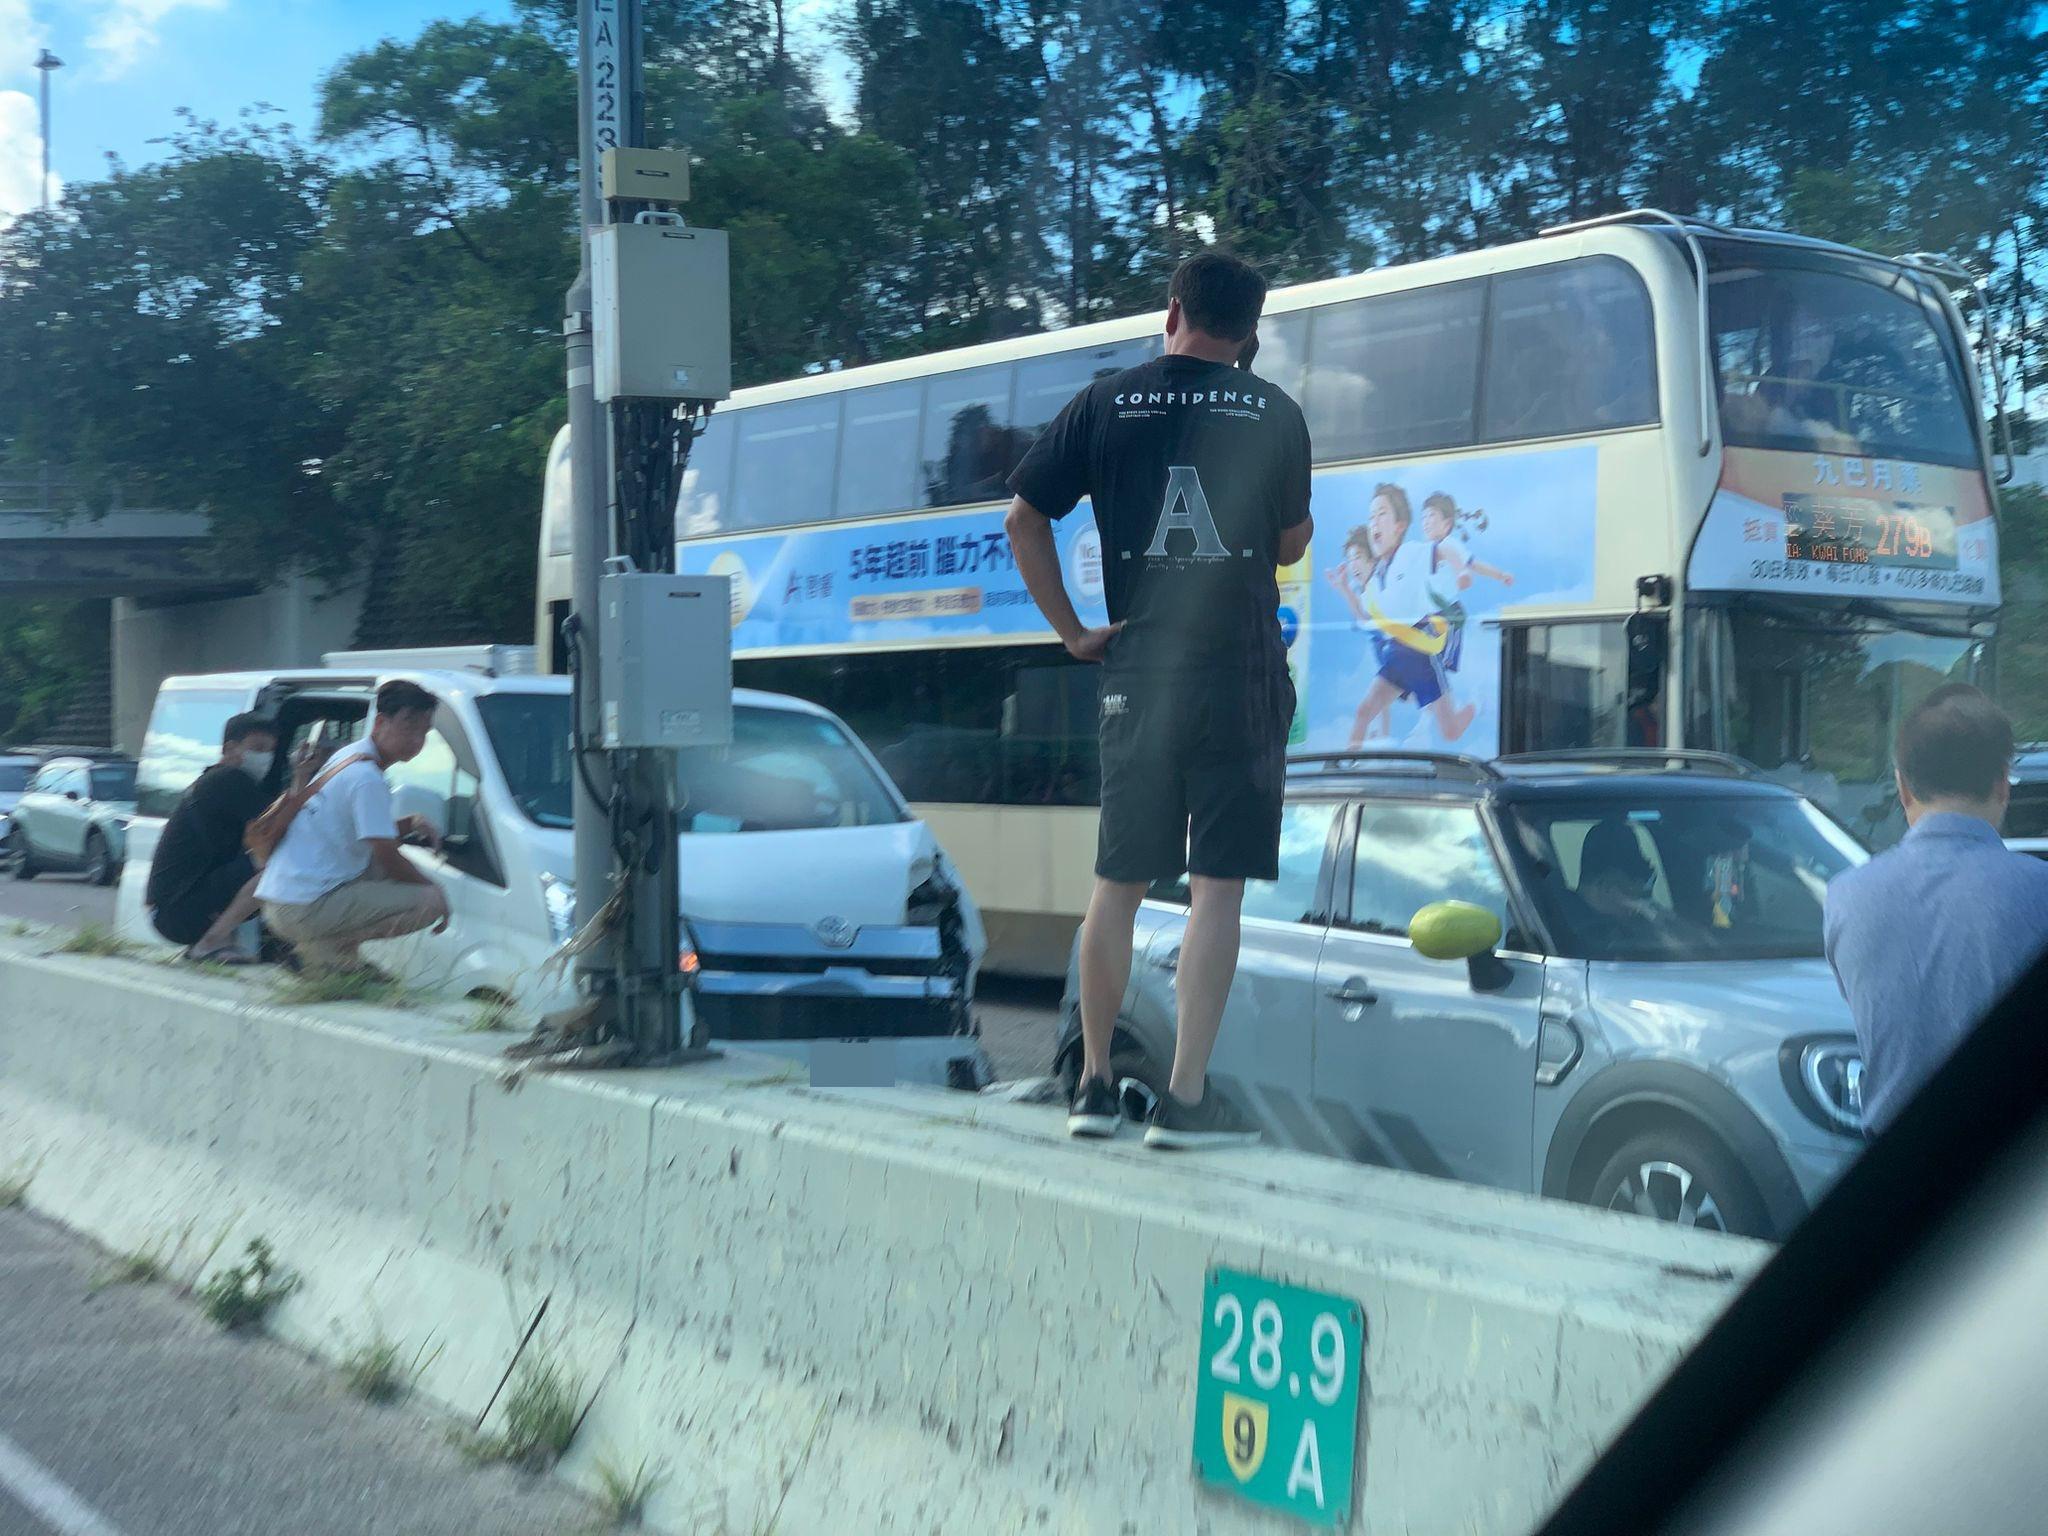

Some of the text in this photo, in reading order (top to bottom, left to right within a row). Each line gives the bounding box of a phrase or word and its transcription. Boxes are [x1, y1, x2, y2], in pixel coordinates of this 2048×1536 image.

[1114, 390, 1267, 409] CONFIDENCE
[1143, 466, 1232, 556] A
[935, 530, 1014, 576] 腦力不
[1811, 544, 1838, 561] KWAI
[1211, 1292, 1346, 1406] 28.9
[1233, 1406, 1256, 1466] 9
[1287, 1418, 1325, 1510] A
